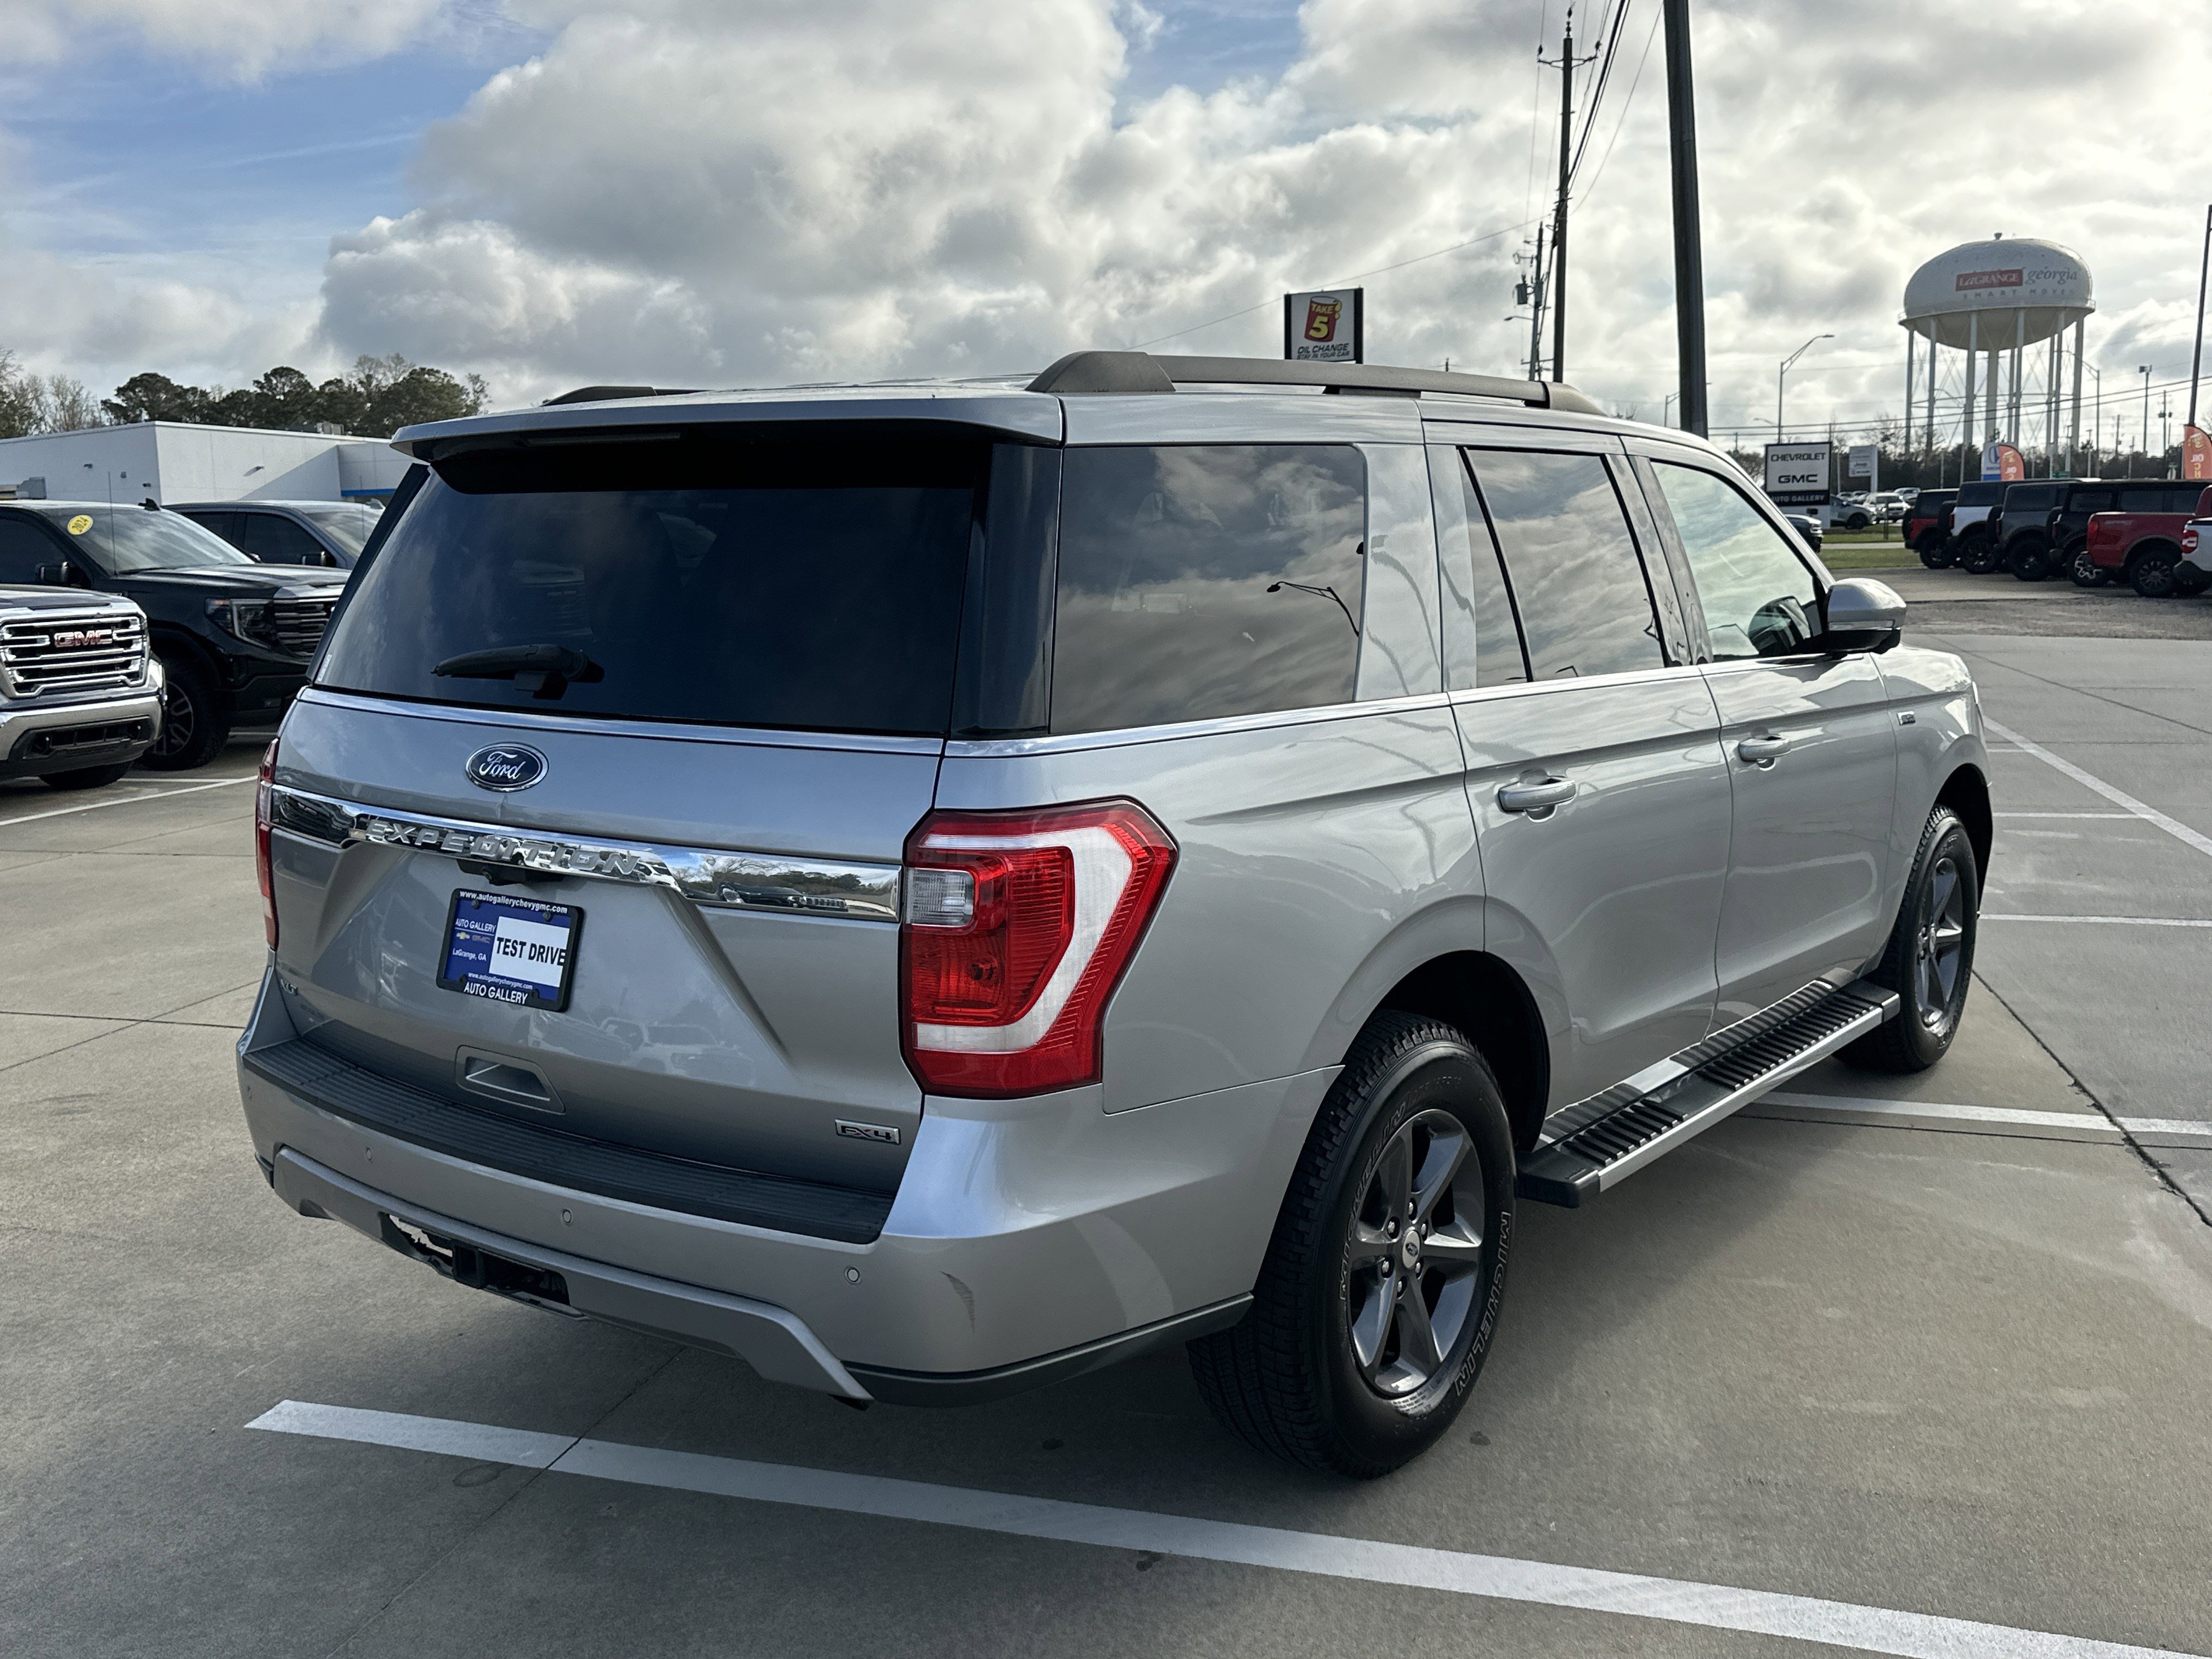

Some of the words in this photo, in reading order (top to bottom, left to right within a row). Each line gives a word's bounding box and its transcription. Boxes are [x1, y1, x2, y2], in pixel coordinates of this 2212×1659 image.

[1311, 303, 1334, 314] TAKE
[1309, 315, 1329, 338] 5
[1312, 343, 1350, 353] CHANGE
[1770, 452, 1826, 462] CHEVROLET
[1778, 473, 1818, 484] GMC
[54, 629, 112, 647] GMC
[479, 751, 526, 780] Ford
[365, 819, 641, 876] EXPEDITION
[460, 890, 568, 914] www.autogallerychevygmc.com
[455, 918, 469, 928] AUTO
[470, 921, 496, 933] GALLERY
[478, 953, 487, 961] GA
[496, 936, 526, 958] TEST
[528, 943, 567, 966] DRIVE
[464, 981, 487, 996] AUTO
[488, 986, 528, 1005] GALLERY
[840, 1125, 892, 1141] FX4
[1455, 1211, 1511, 1396] MICHELIN
